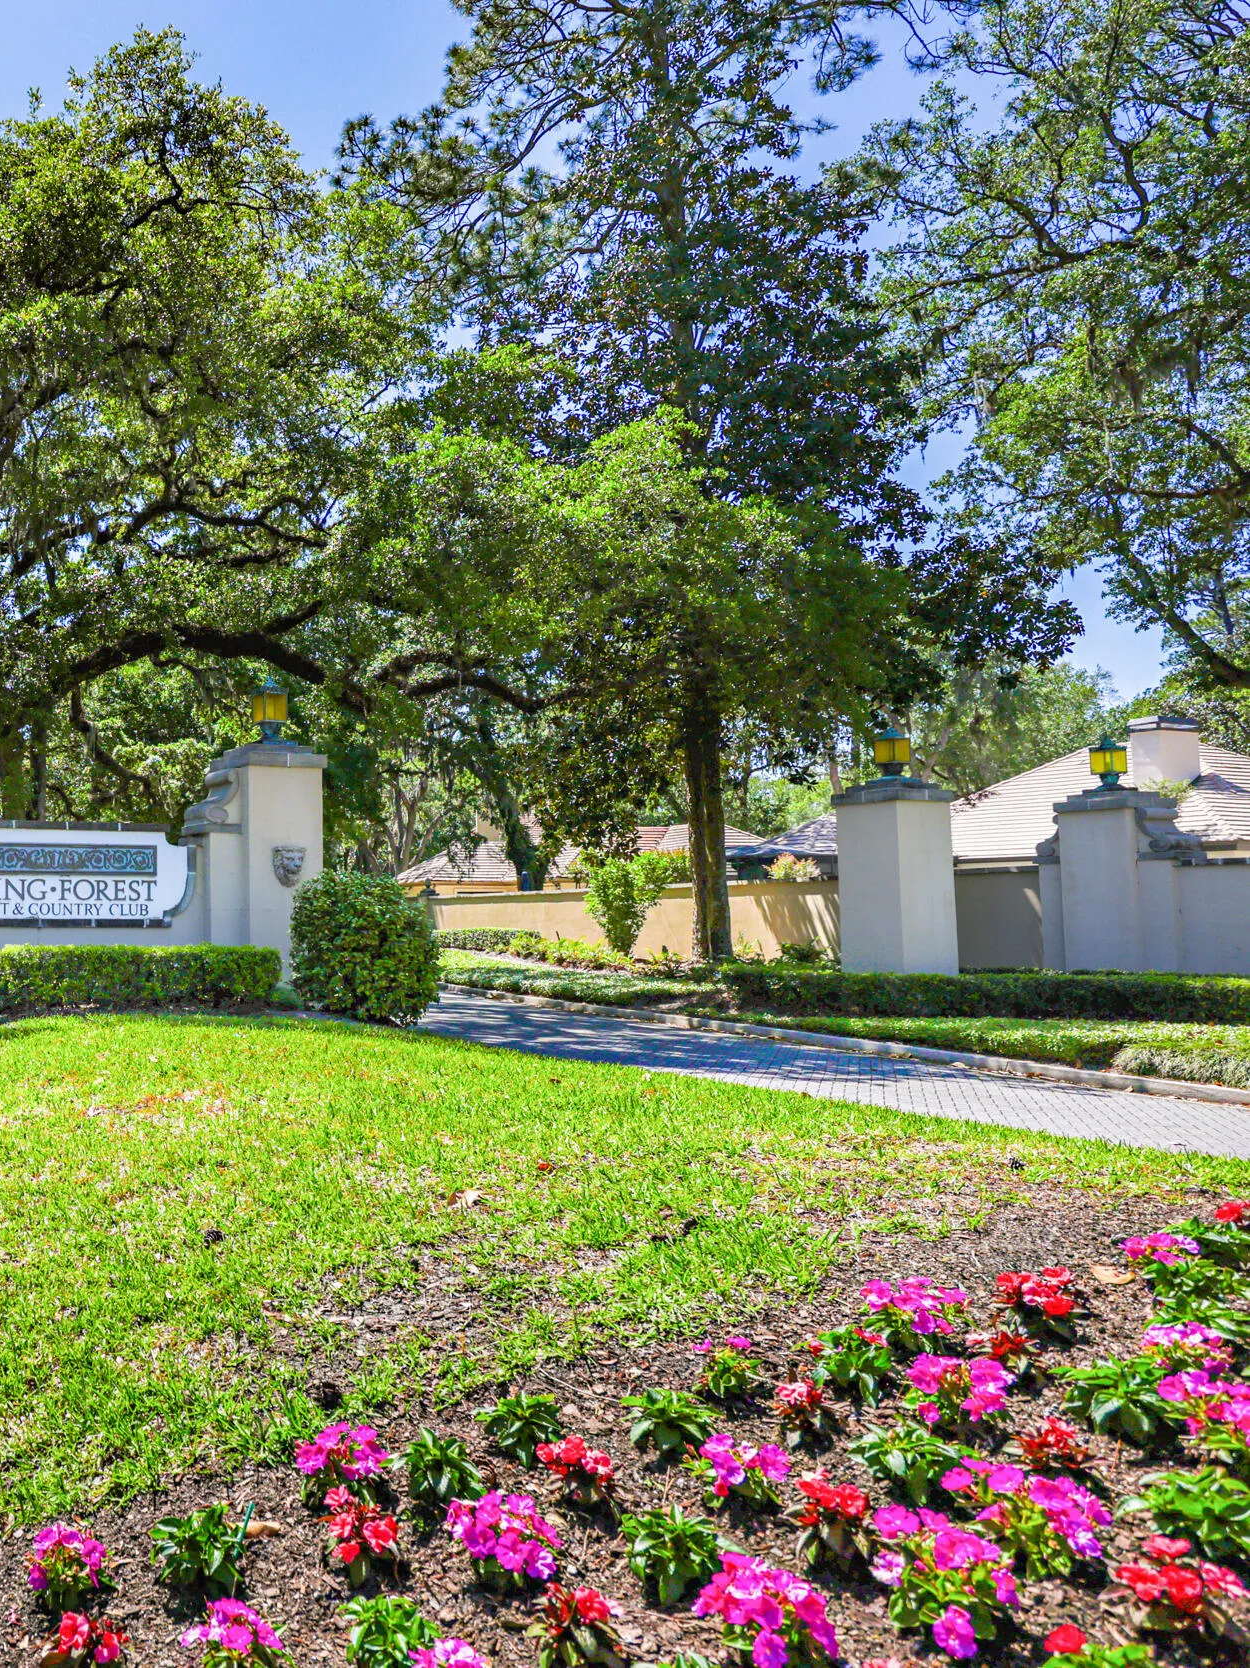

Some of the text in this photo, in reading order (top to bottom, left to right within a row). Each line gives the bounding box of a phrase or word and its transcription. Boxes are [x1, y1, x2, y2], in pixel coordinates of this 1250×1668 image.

[12, 902, 24, 915] &
[28, 903, 103, 916] COUNTRY
[109, 904, 149, 916] CLUB
